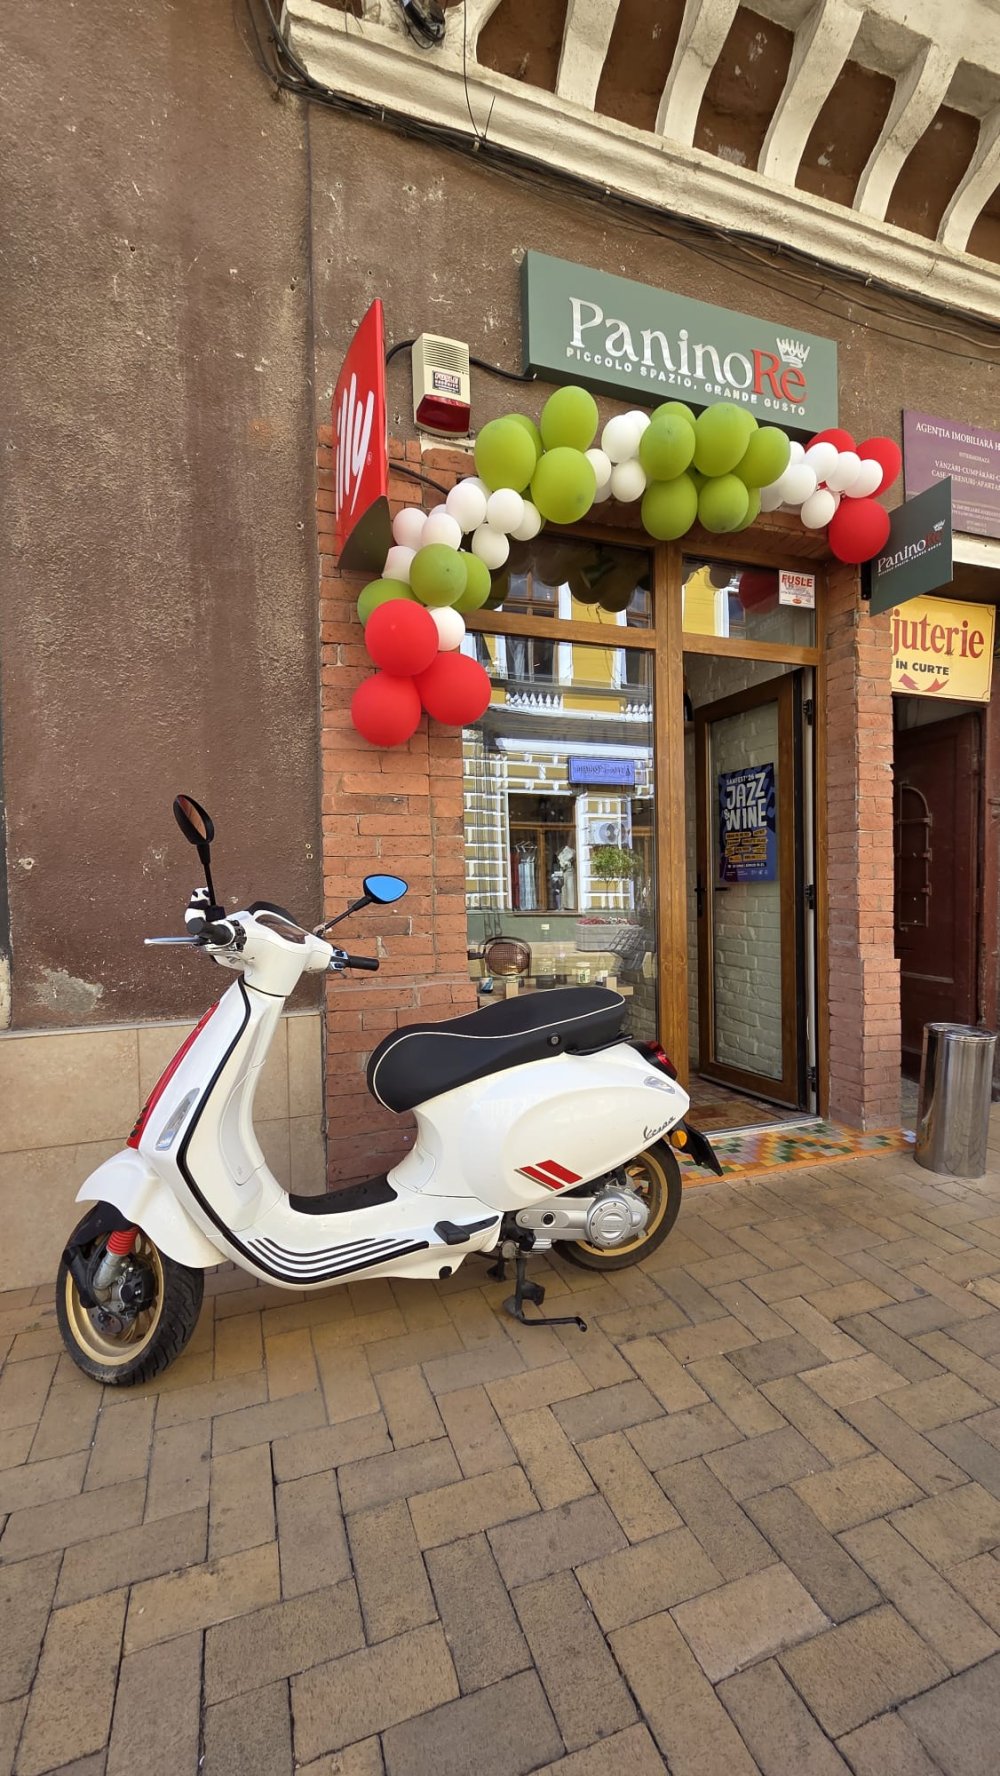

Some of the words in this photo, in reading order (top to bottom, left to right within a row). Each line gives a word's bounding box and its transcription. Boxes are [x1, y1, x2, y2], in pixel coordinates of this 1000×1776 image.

[566, 346, 632, 372] PICCOLO
[640, 366, 697, 390] SPAZIO,
[704, 382, 758, 404] GRANDE
[764, 398, 806, 416] GUSTO
[335, 372, 374, 522] illy
[951, 431, 994, 450] IMOBILIARĂ
[912, 662, 950, 676] CURTE
[726, 772, 766, 810] JAZZ
[726, 798, 767, 831] WINE
